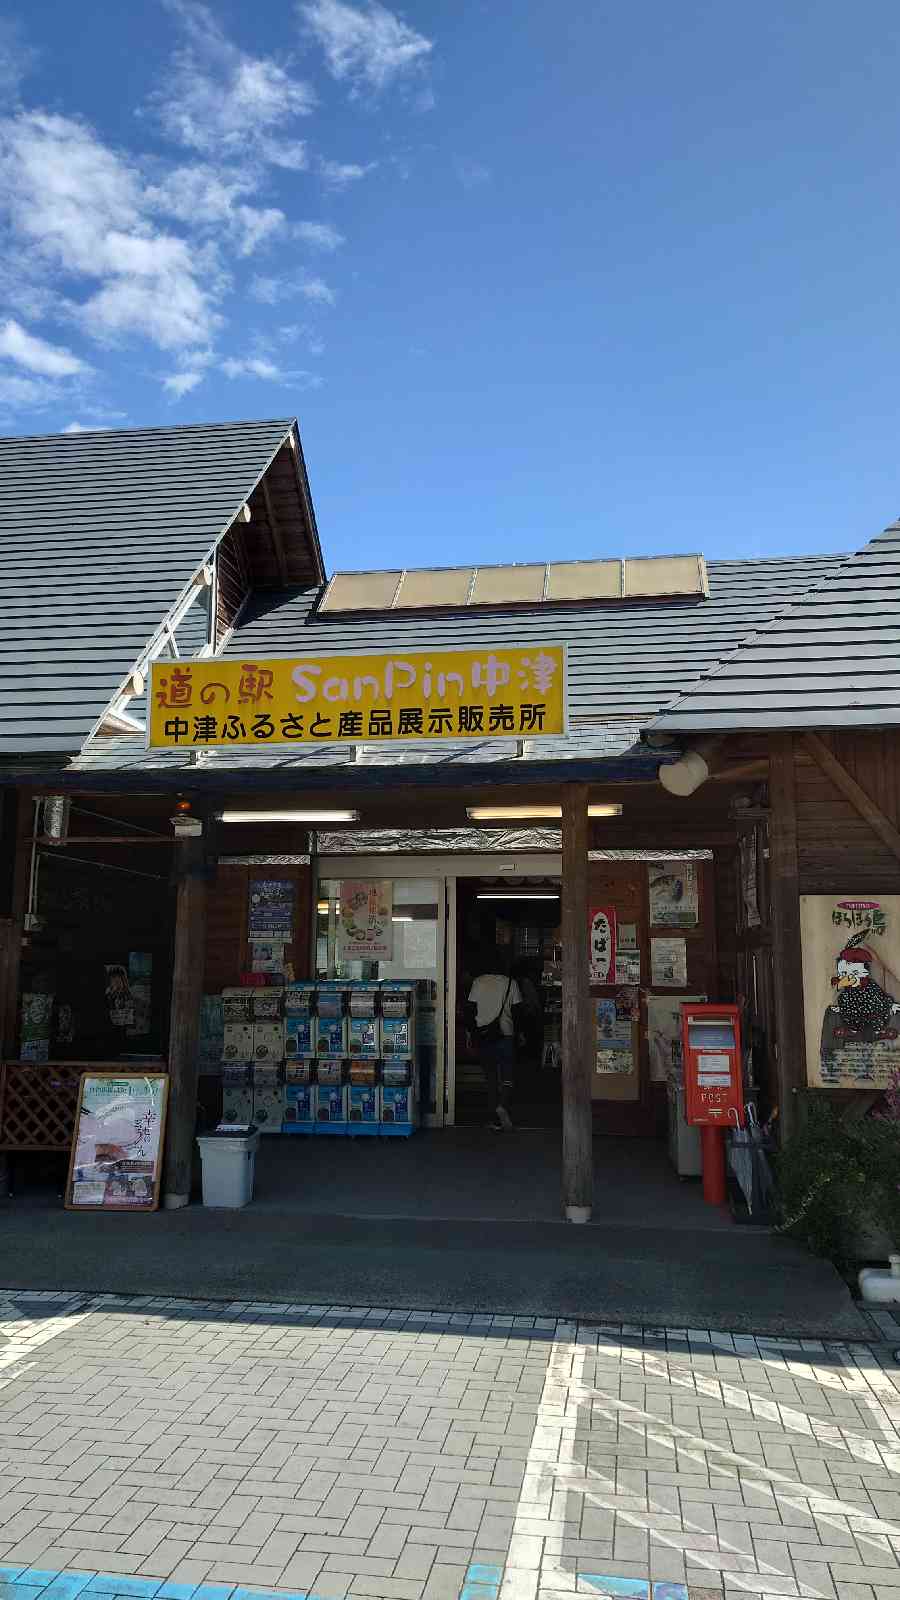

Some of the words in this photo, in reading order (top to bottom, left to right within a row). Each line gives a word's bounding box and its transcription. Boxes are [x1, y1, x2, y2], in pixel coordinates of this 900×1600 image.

[155, 663, 274, 708] 道の駅
[291, 651, 558, 702] SanPin中津
[164, 703, 546, 742] 中津ふるさと産品展示販売所
